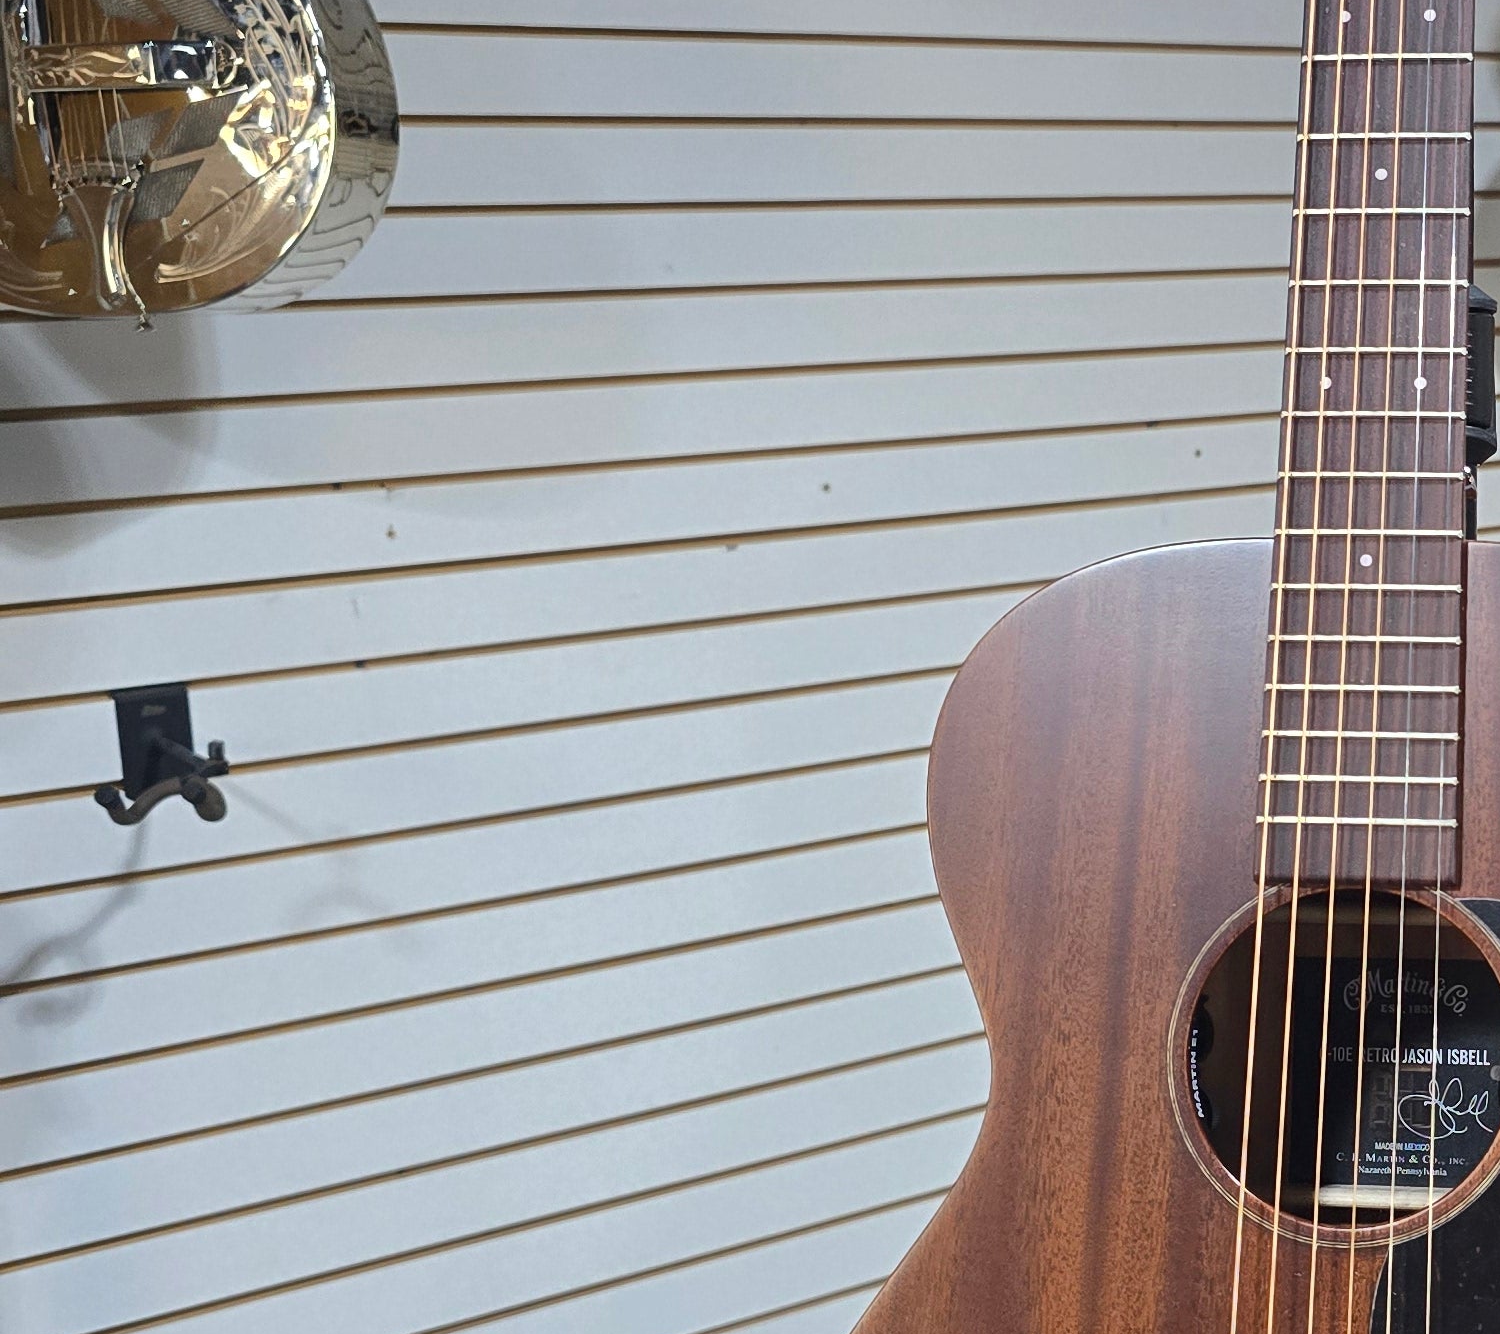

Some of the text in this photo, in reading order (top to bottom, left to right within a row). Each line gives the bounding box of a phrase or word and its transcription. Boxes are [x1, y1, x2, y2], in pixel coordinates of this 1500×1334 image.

[1402, 1048, 1444, 1065] JASON
[1447, 1049, 1491, 1066] ISBELL
[1190, 1051, 1205, 1118] MARTIN
